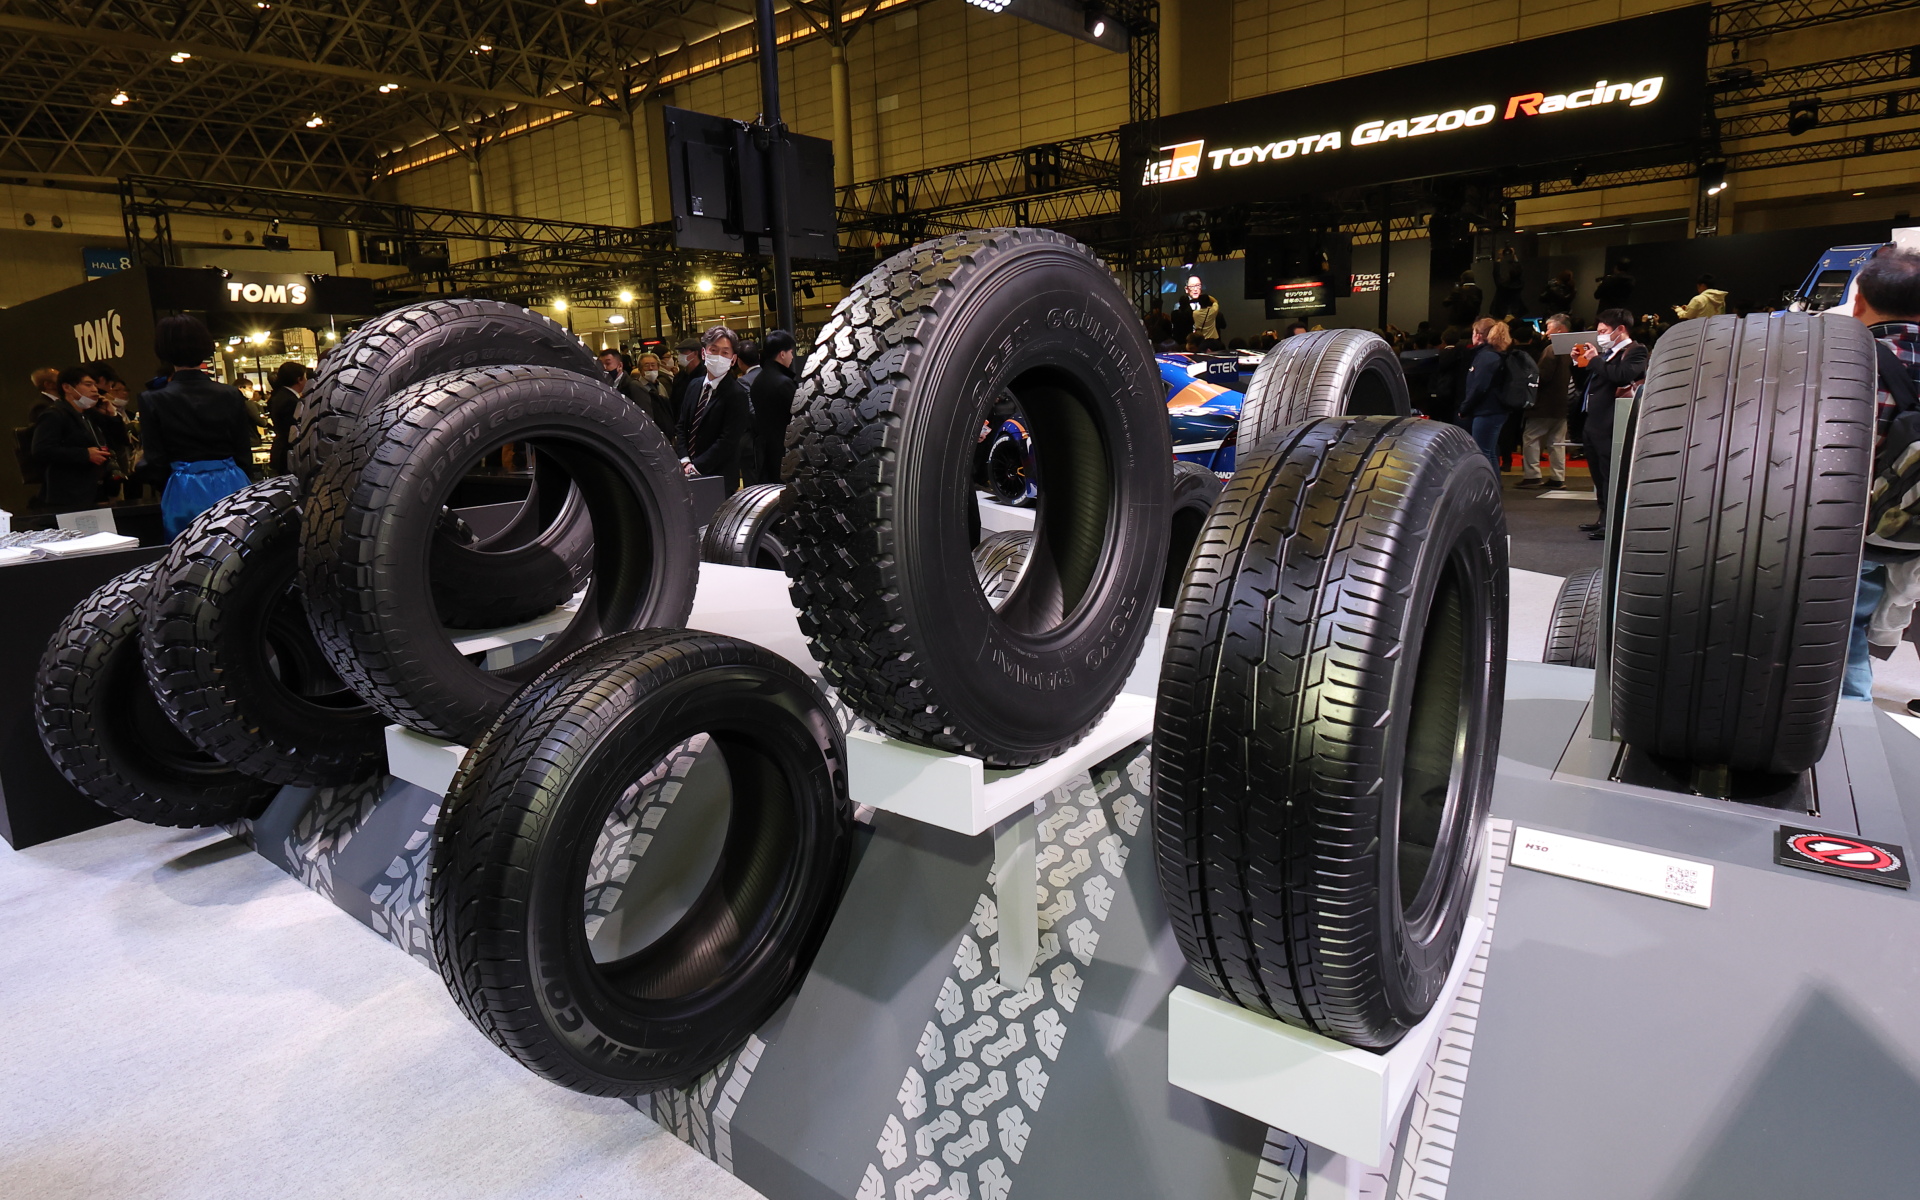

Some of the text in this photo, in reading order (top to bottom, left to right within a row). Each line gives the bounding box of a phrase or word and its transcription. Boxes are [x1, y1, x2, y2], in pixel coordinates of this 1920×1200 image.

[1208, 131, 1342, 170] TOYOTA
[1350, 103, 1497, 147] GAZOO
[1503, 76, 1664, 120] Racing
[92, 257, 131, 270] HALL 8
[1356, 272, 1395, 280] TOYOA
[227, 282, 307, 305] TOM'S
[73, 309, 125, 363] TOM'S
[972, 308, 1144, 409] OPEN COUNTRY
[1208, 361, 1237, 374] CTEK
[419, 422, 481, 504] OPEN
